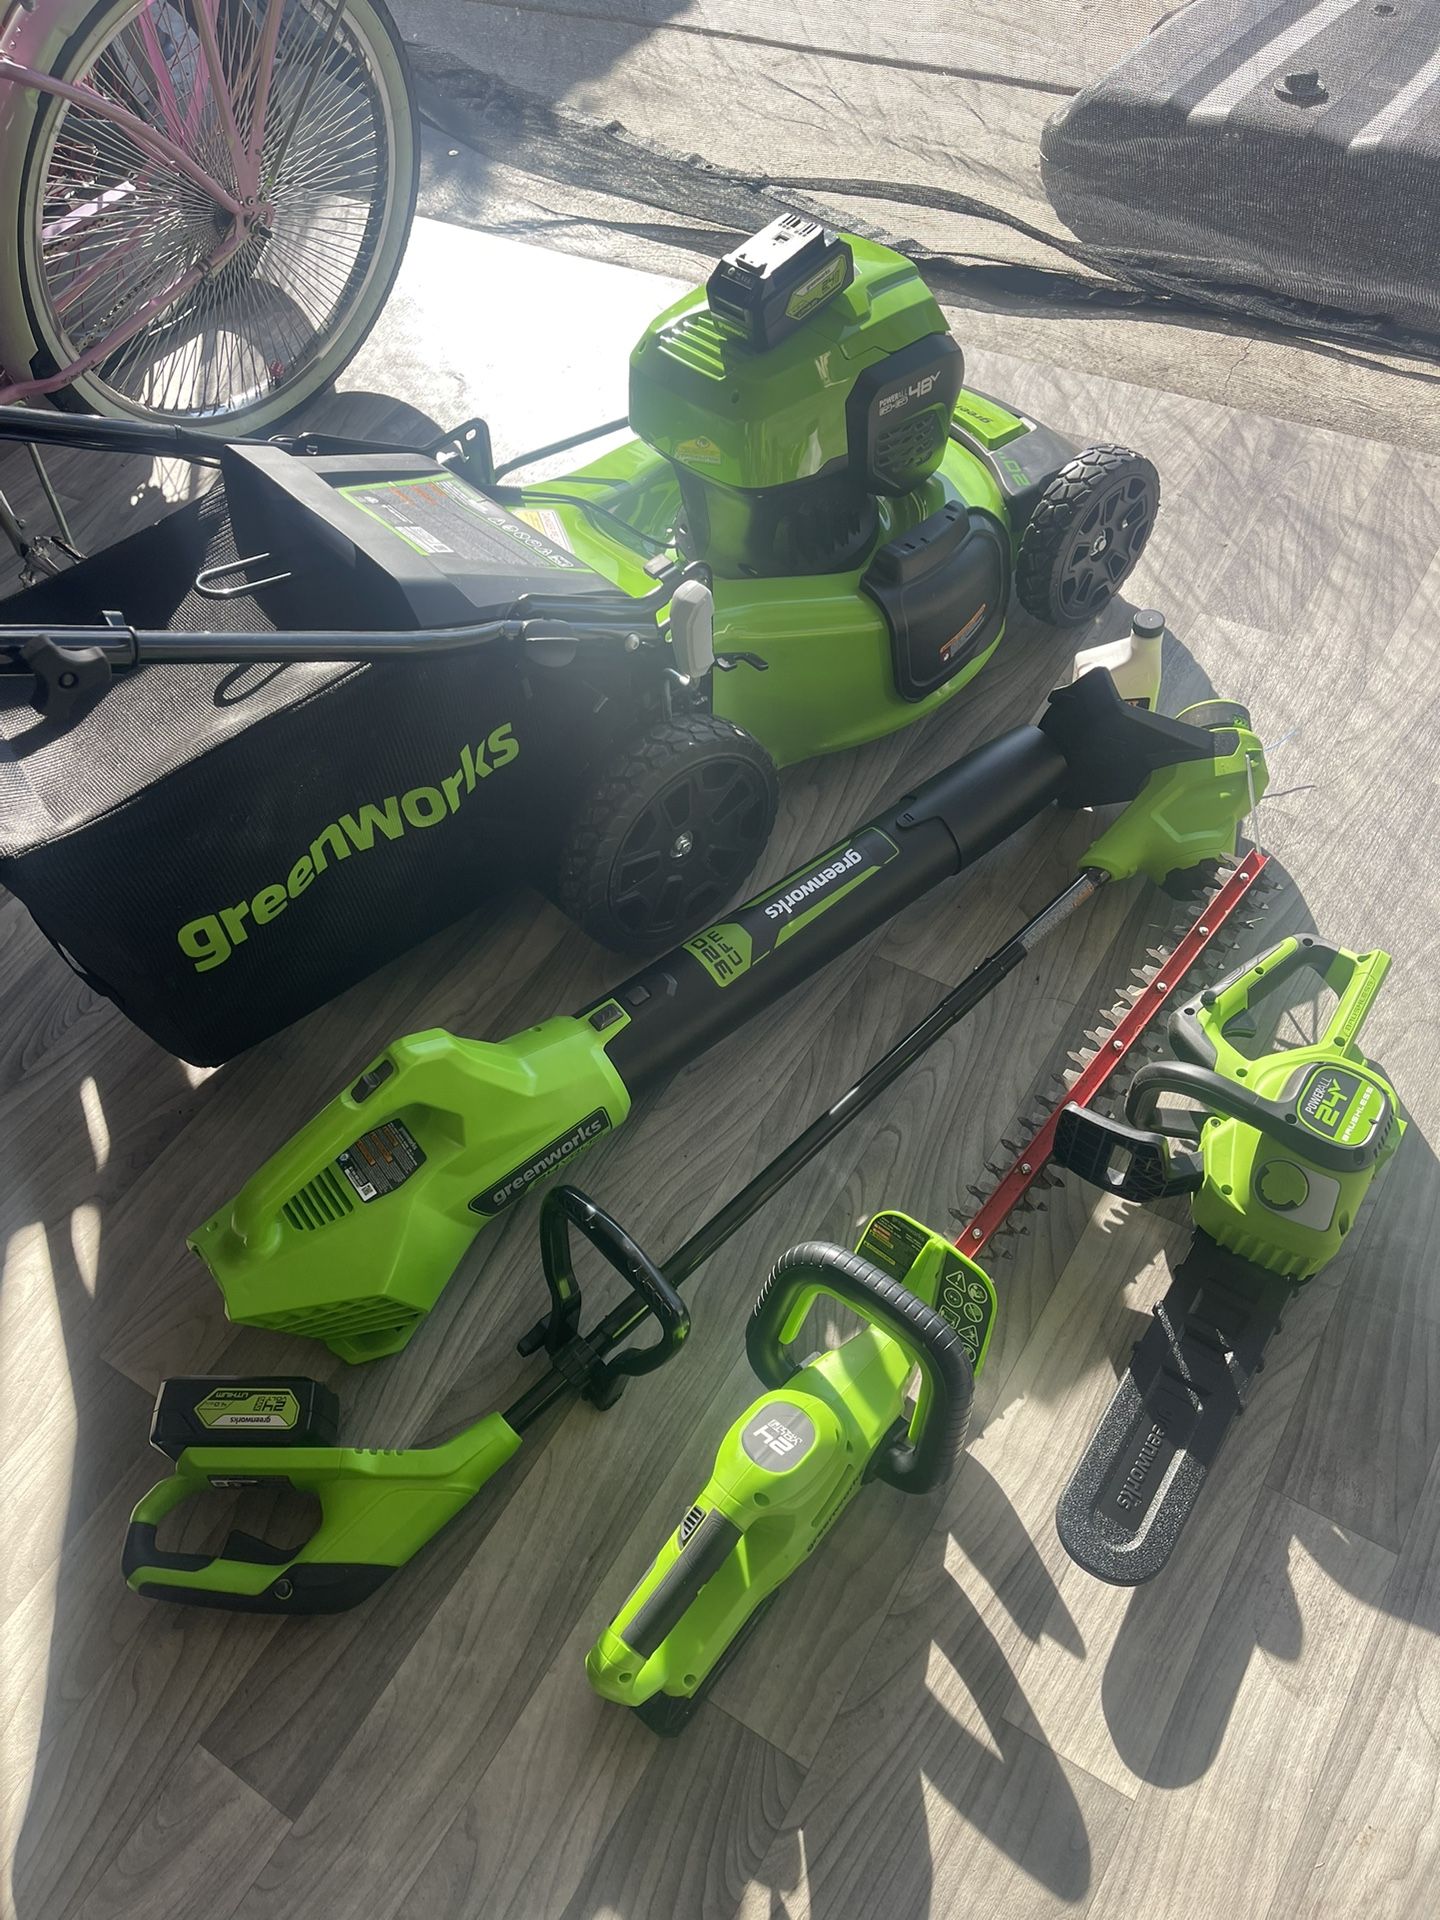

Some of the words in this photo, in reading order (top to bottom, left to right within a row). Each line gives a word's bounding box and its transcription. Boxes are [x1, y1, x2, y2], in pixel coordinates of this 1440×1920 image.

[177, 722, 520, 973] greenworks
[764, 848, 863, 919] greenworks
[690, 938, 734, 981] 320
[707, 930, 744, 967] CFM
[1304, 1077, 1333, 1115] POWERALL
[1314, 1078, 1348, 1127] 24V
[1341, 1086, 1375, 1143] BRUSHLESS
[492, 1120, 602, 1207] greenworks
[229, 1415, 272, 1425] greenworks
[752, 1424, 795, 1456] 24
